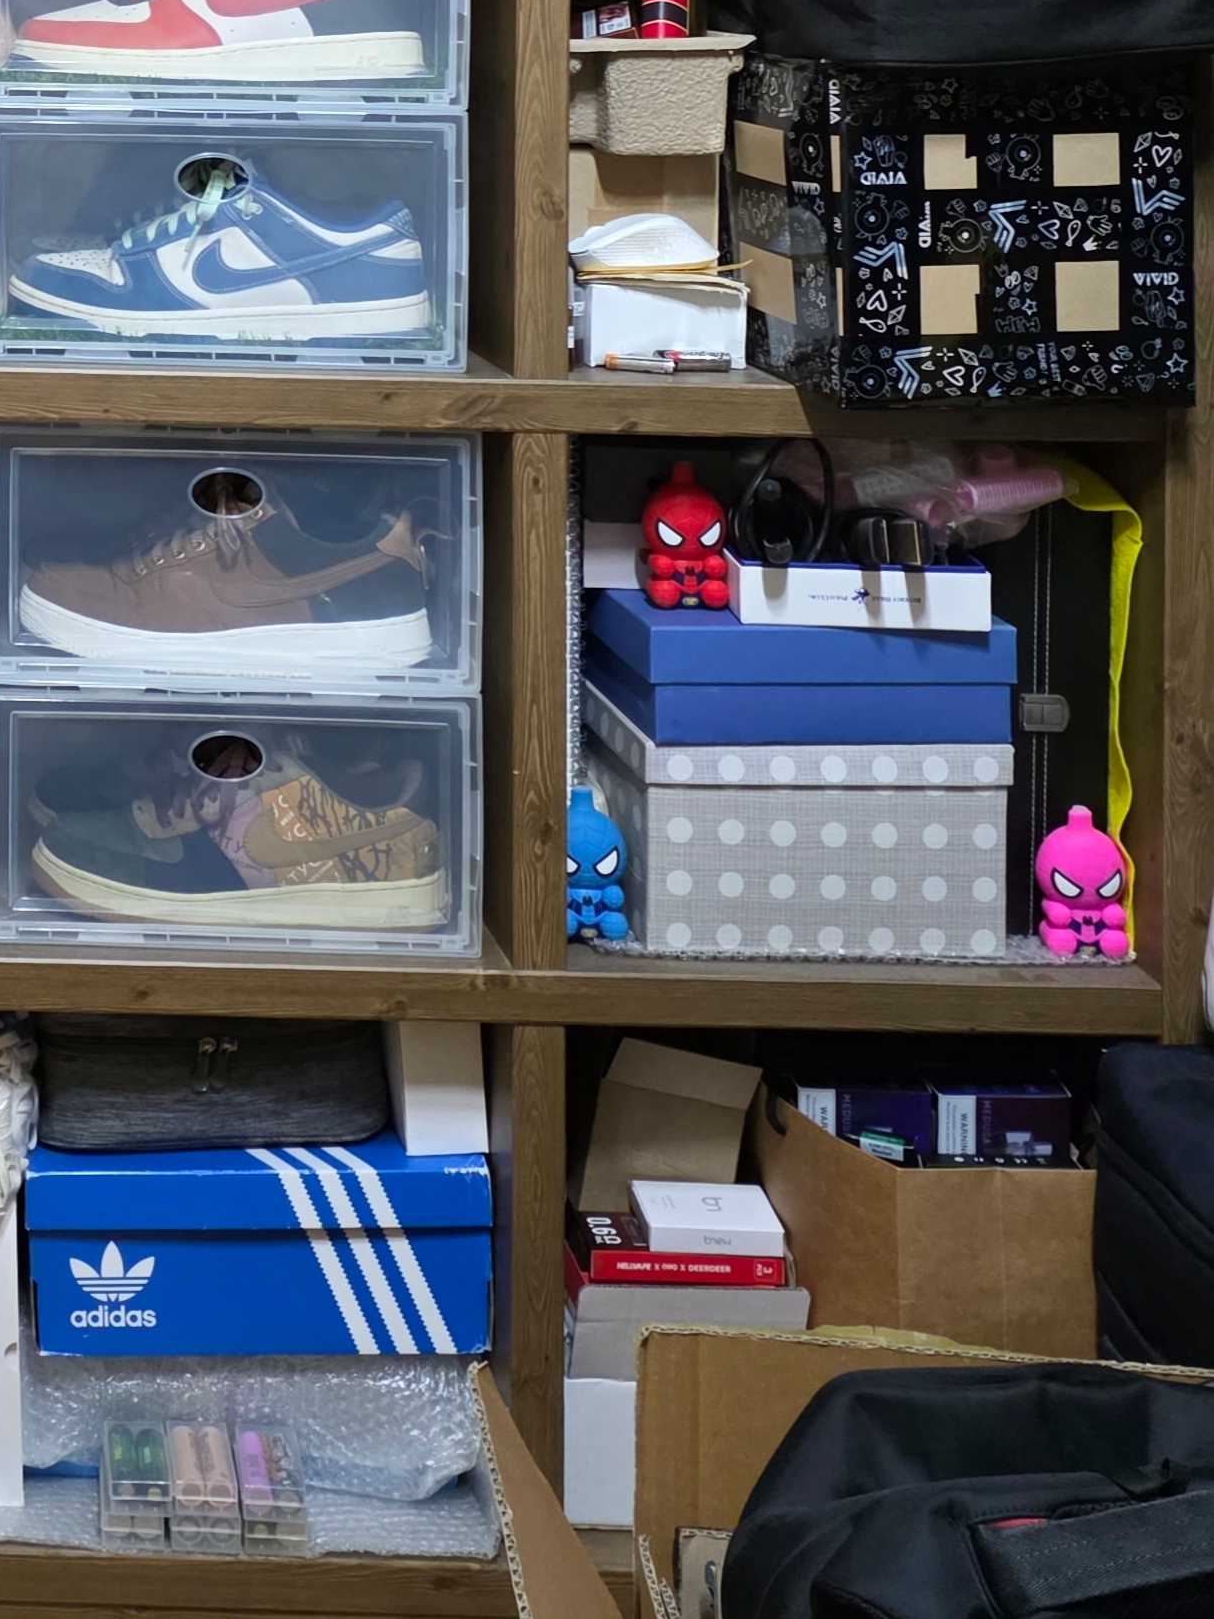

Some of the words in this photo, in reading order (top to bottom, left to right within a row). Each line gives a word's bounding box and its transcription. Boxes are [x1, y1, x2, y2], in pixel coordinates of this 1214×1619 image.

[828, 78, 841, 125] VIVID
[791, 181, 821, 195] VIVID
[859, 171, 907, 185] VIVID
[1133, 271, 1180, 286] VIVID
[982, 1100, 992, 1145] MEDUSA
[586, 1216, 622, 1245] 0.6Ω
[688, 1264, 732, 1273] DEERDEER
[70, 1303, 157, 1328] adidas
